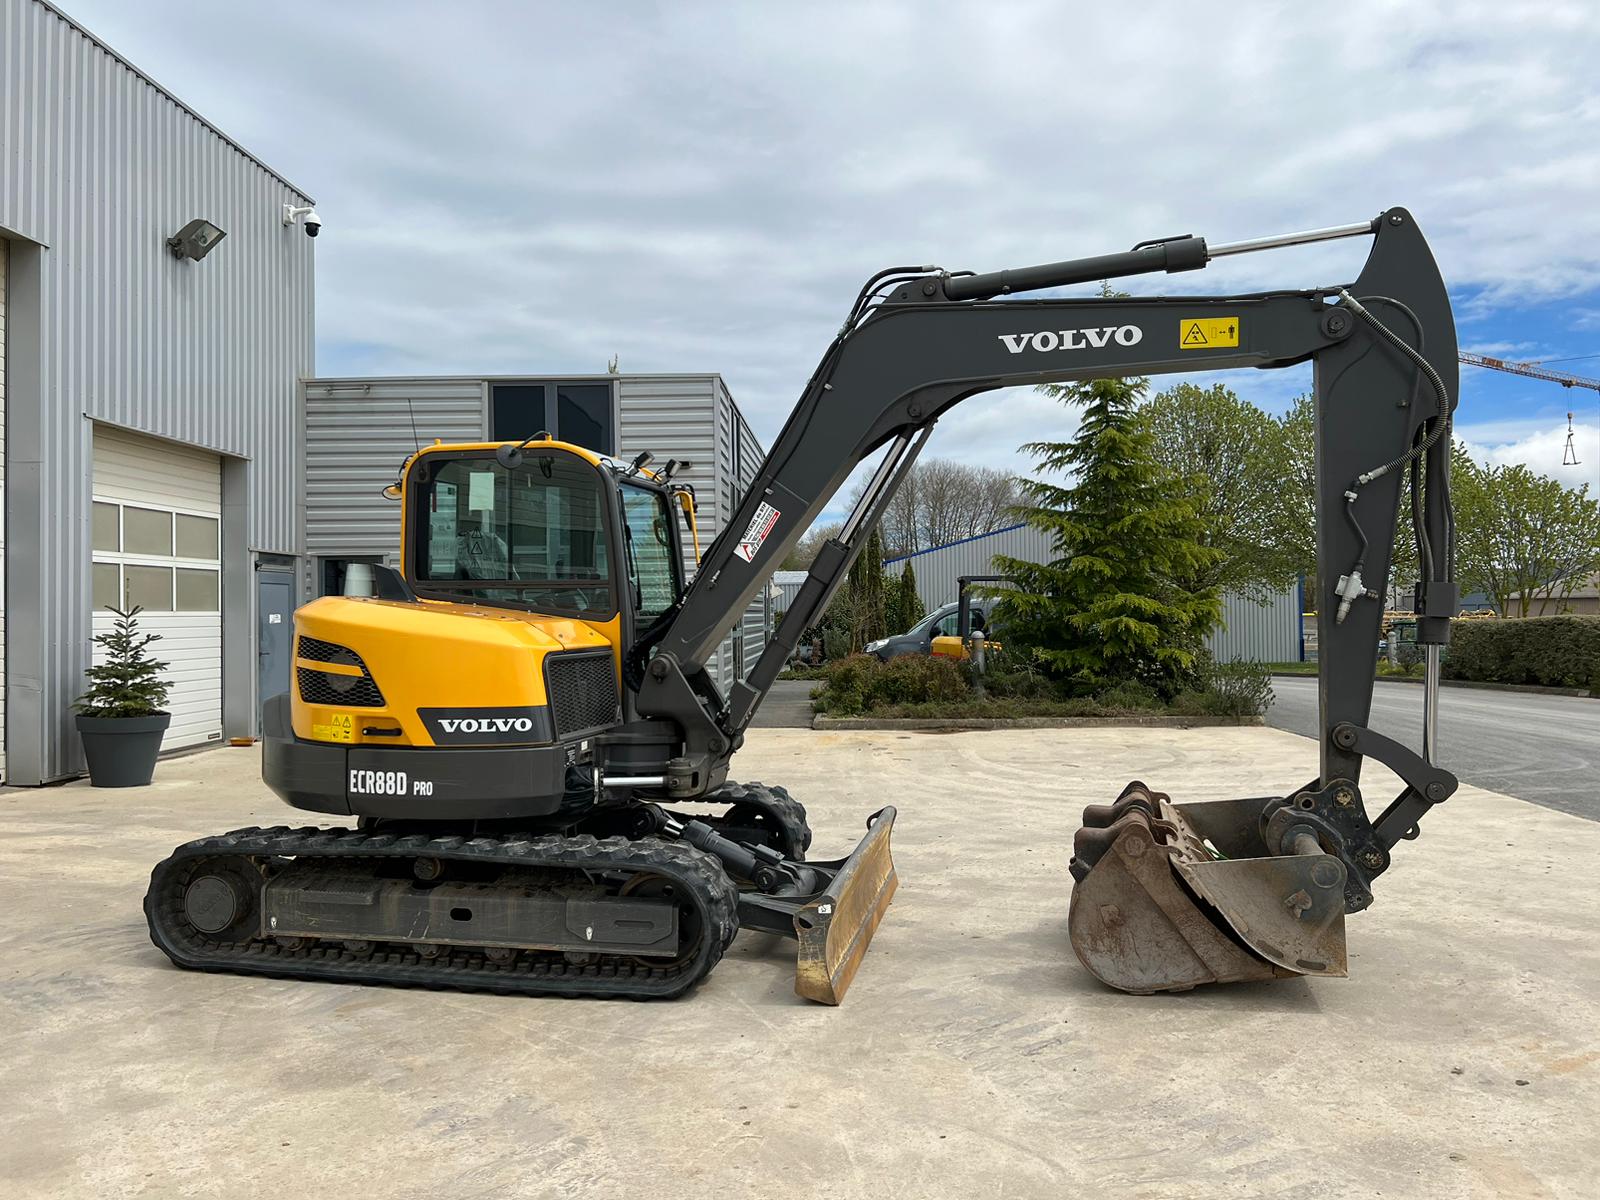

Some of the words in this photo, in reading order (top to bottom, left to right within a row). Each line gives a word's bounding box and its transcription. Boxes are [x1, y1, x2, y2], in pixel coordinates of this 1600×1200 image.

[998, 324, 1143, 354] VOLVO
[438, 717, 533, 733] VOLVO
[349, 769, 407, 796] ECR88D
[413, 781, 433, 797] PRO
